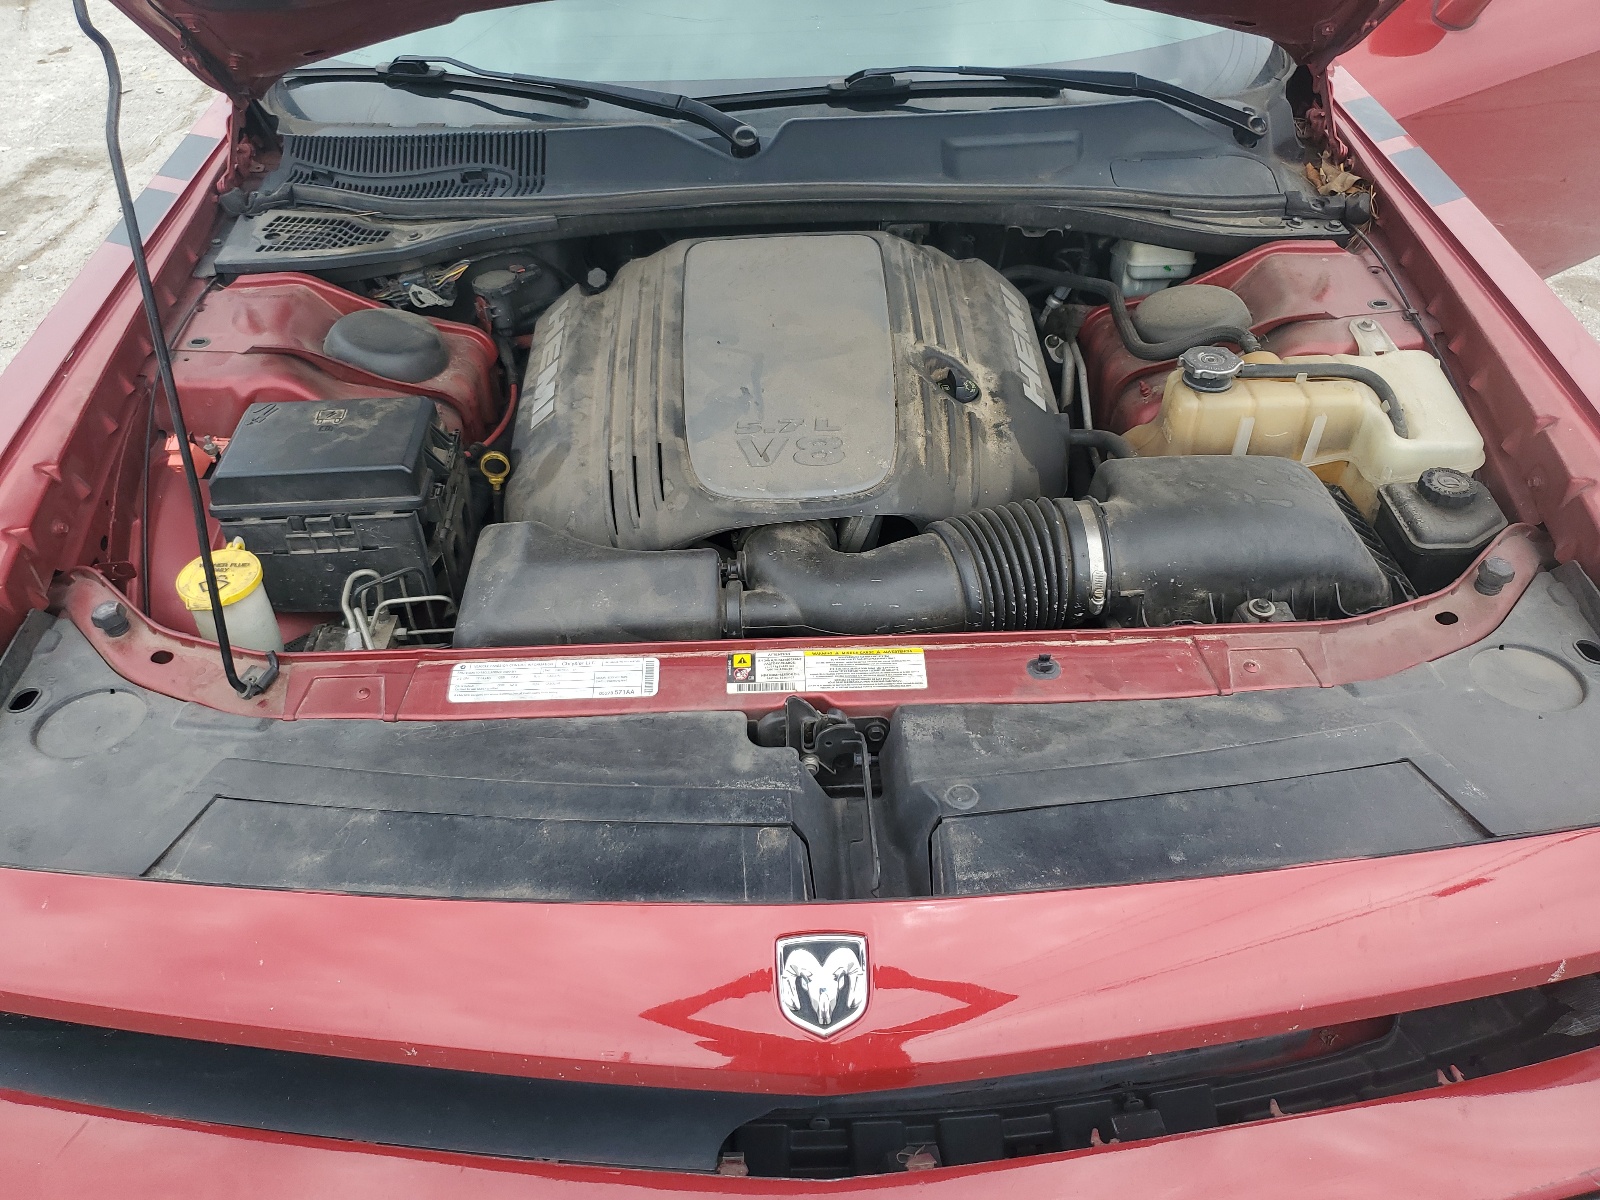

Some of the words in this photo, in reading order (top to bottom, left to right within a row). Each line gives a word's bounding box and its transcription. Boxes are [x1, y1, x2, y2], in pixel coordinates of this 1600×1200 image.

[530, 300, 569, 430] HEMI
[1000, 283, 1047, 412] HEMI
[736, 436, 845, 467] V8
